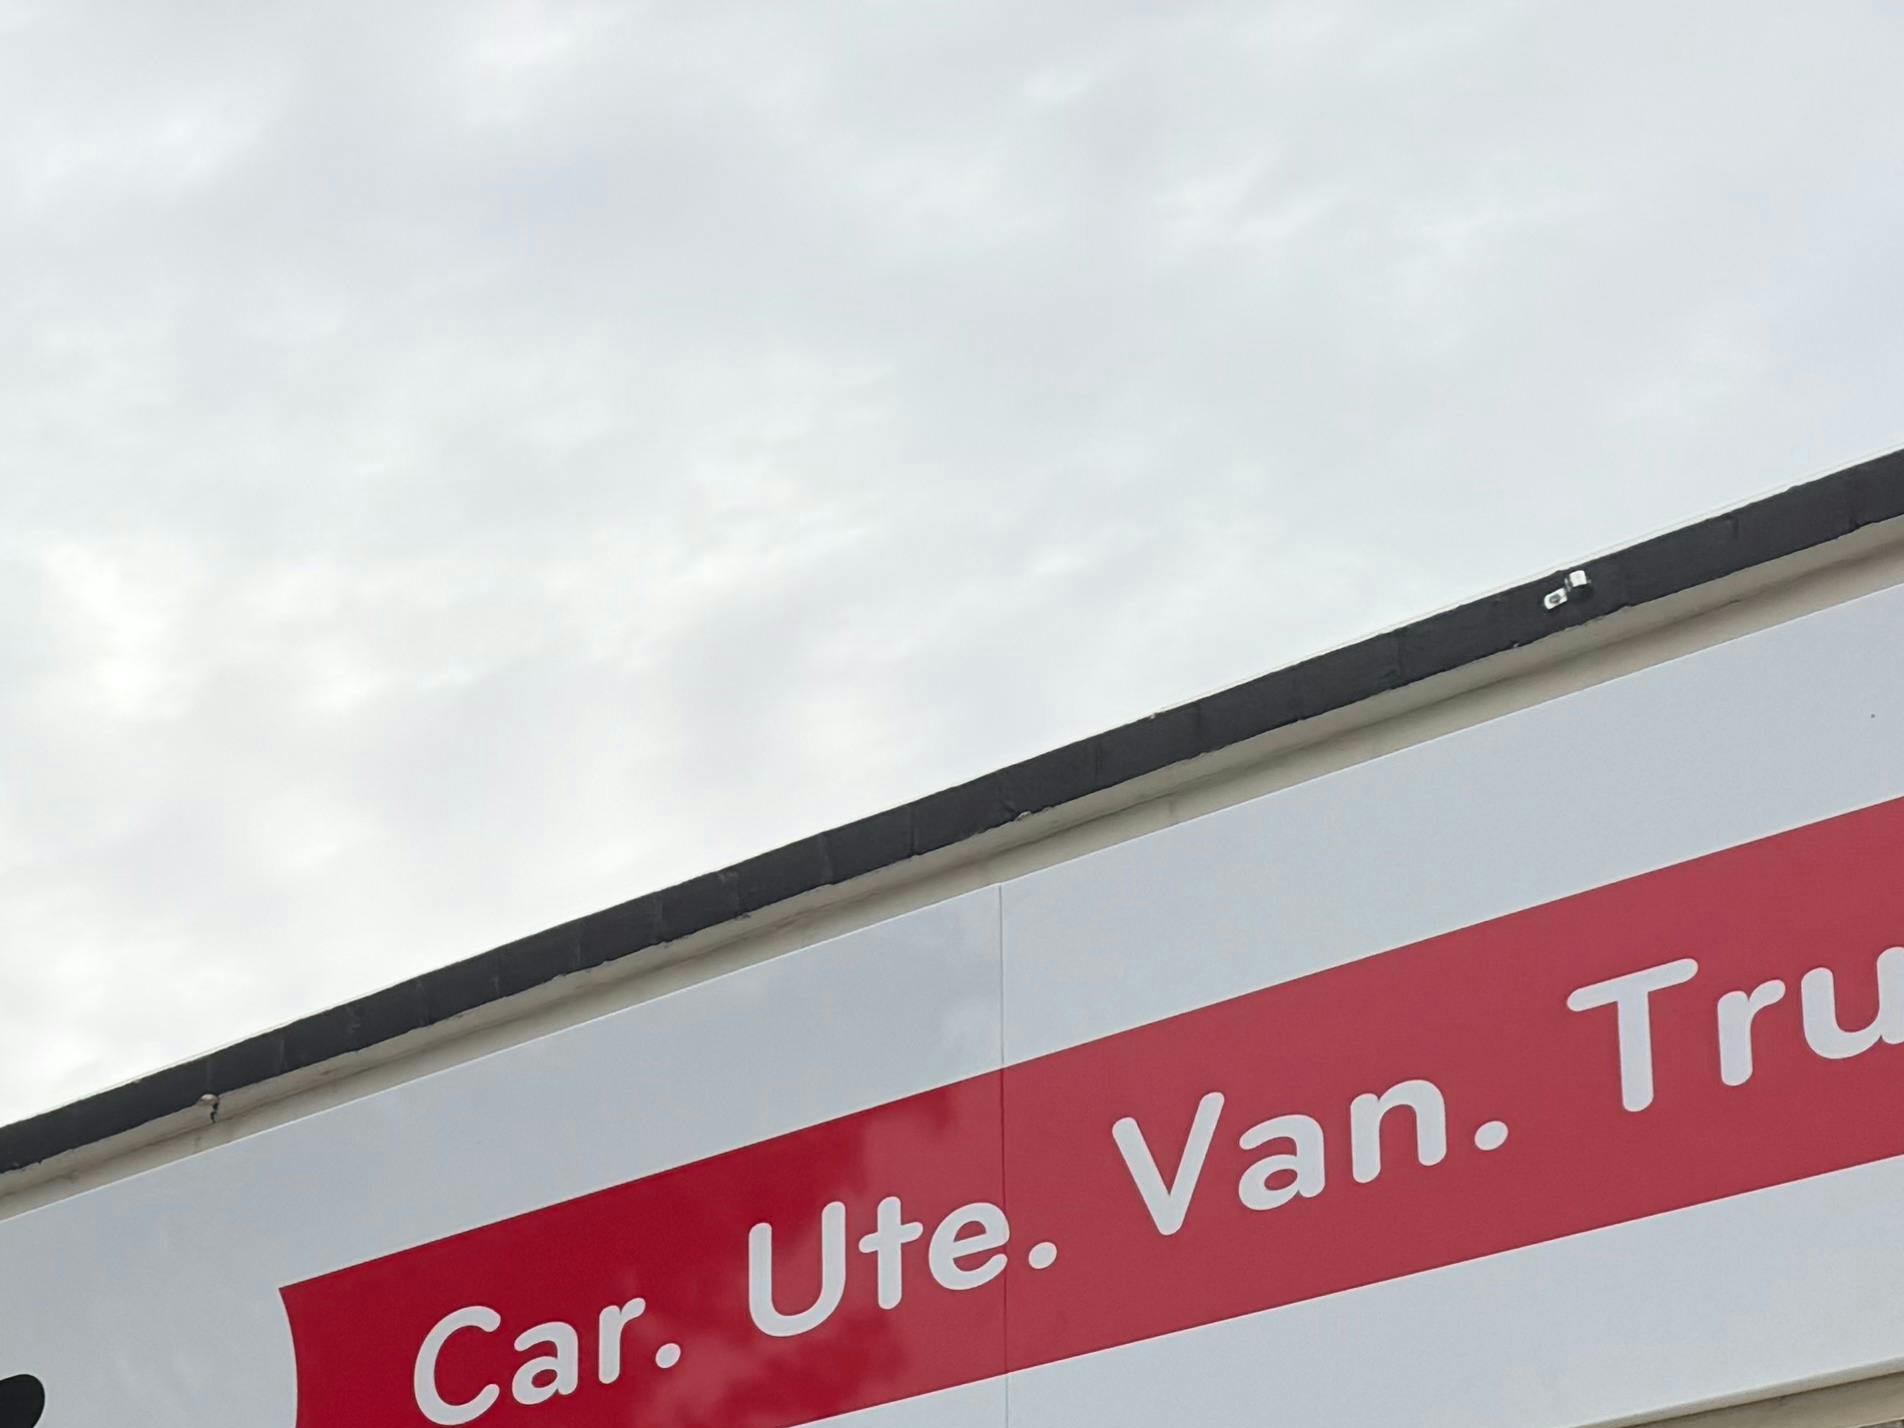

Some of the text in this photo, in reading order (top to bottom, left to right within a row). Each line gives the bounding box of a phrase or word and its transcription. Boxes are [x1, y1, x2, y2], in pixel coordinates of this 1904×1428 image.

[412, 1305, 684, 1428] Car.
[746, 1200, 1059, 1338] Ute.
[1110, 1074, 1510, 1237] Van.
